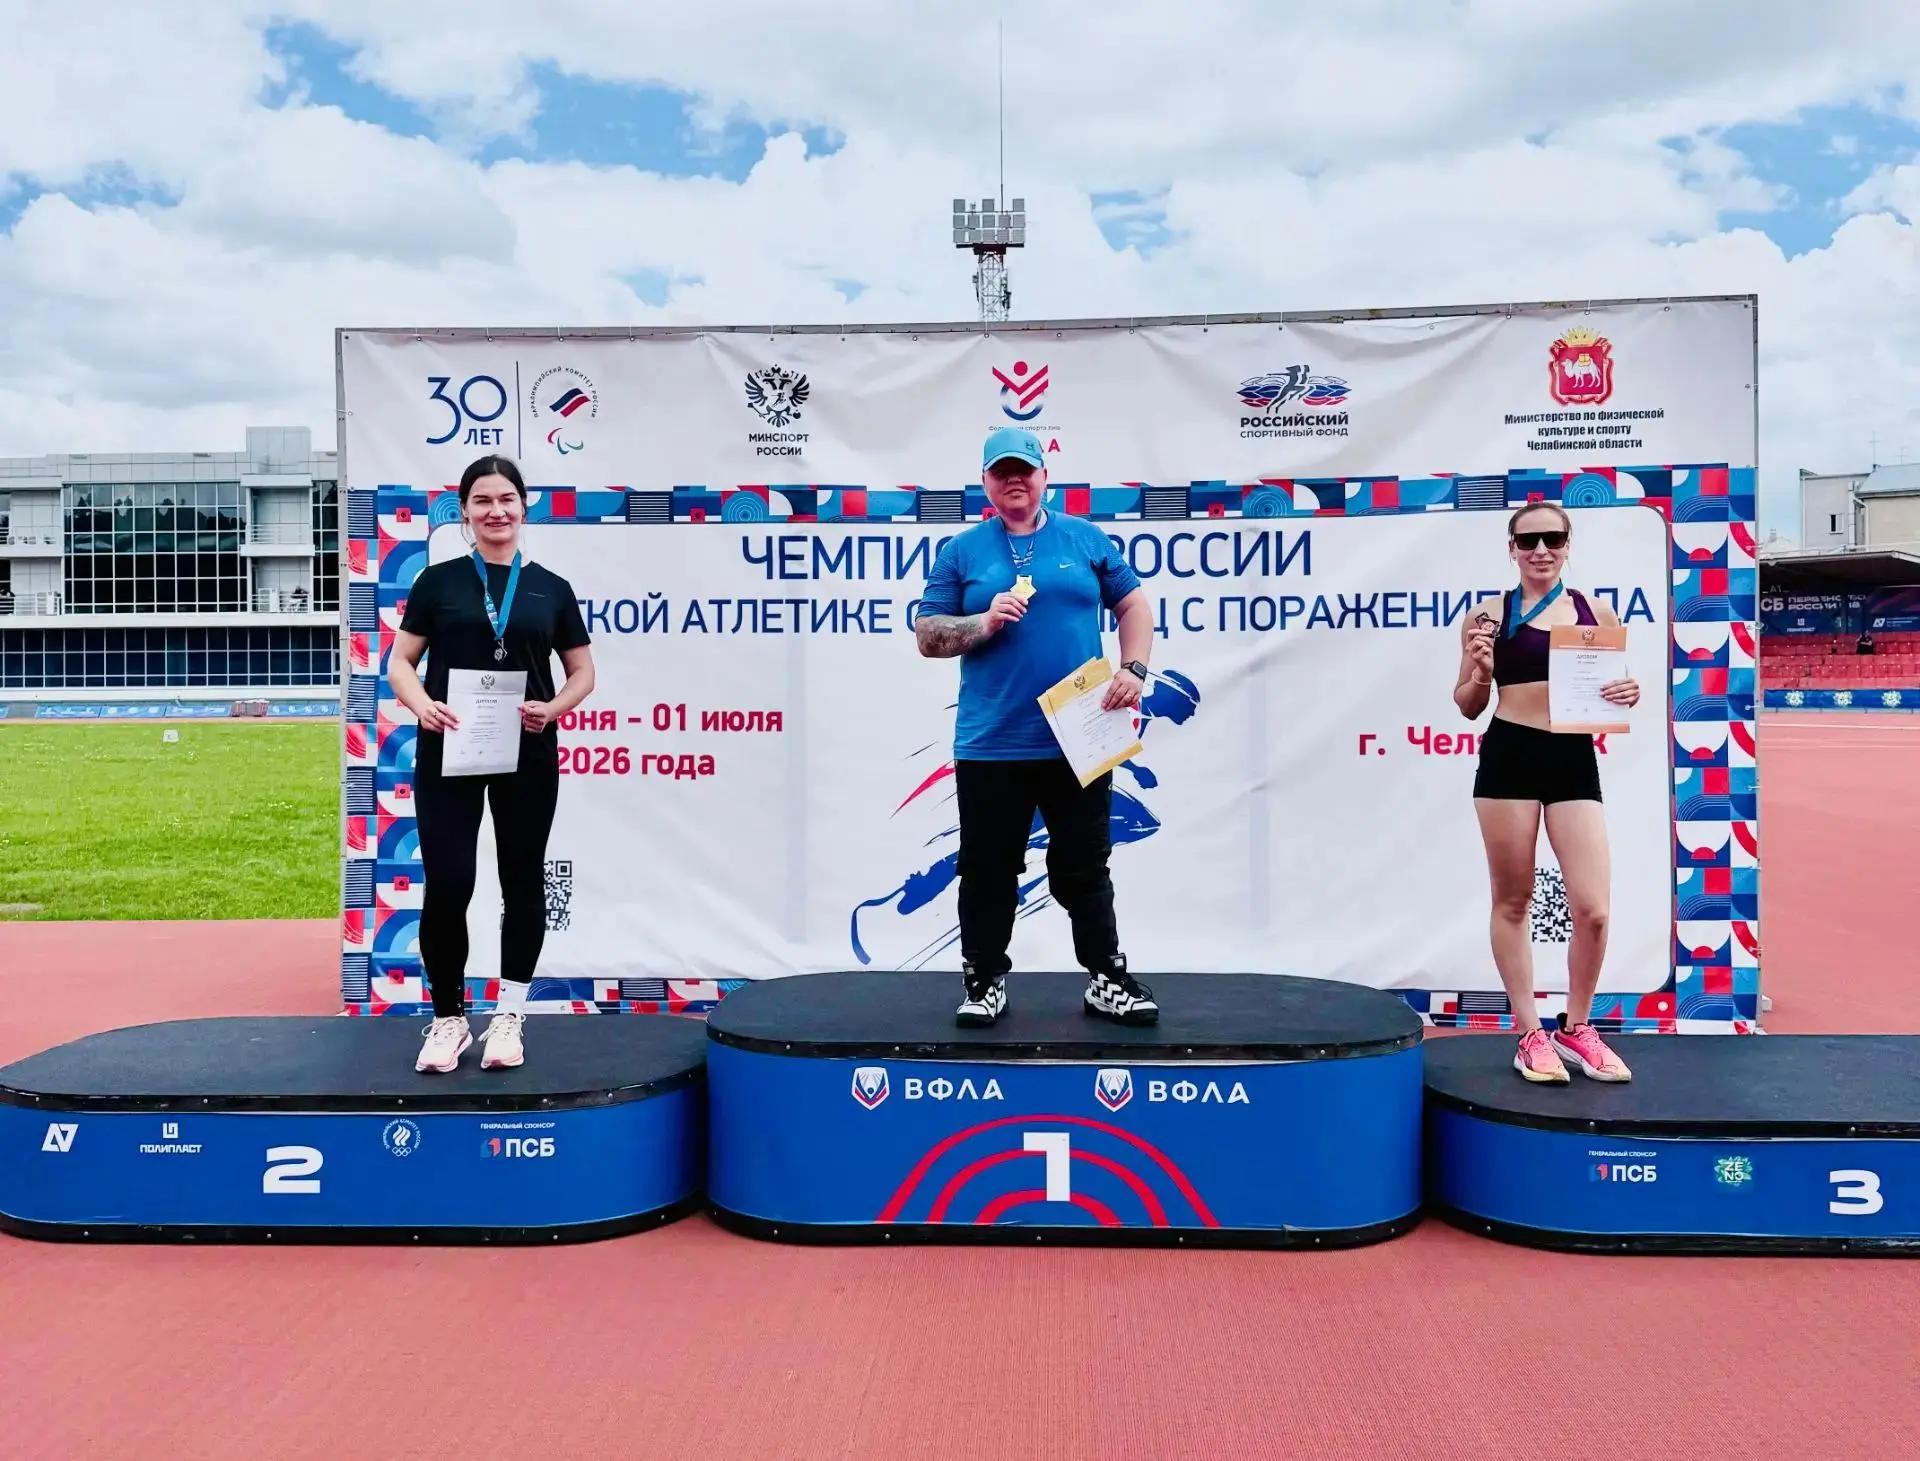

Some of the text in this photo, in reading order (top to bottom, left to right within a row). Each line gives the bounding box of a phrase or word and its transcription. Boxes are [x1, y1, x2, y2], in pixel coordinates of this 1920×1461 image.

[426, 375, 507, 444] 30
[1505, 407, 1665, 425] Министерство по физической
[1240, 411, 1349, 428] РОССИЙСКИЙ
[464, 428, 504, 445] ЛЕТ
[748, 433, 809, 443] МИНСПОРТ
[1240, 427, 1349, 438] СПОРТИВНЫЙ ФОНД
[1538, 424, 1631, 437] культуре и спорту
[756, 447, 802, 456] РОССИИ
[1527, 438, 1643, 451] Челябинской области
[742, 535, 954, 580] ЧЕМПИ
[1760, 597, 1785, 612] СБ
[681, 599, 893, 634] АТЛЕТИКЕ
[1182, 597, 1205, 632] С
[556, 710, 617, 731] юня
[653, 703, 687, 732] 01
[701, 711, 783, 732] июля
[1359, 734, 1386, 756] г.
[558, 747, 716, 780] 2026 года
[904, 1077, 1005, 1101] ВФЛА
[1148, 1080, 1250, 1104] ВФЛА
[480, 1121, 556, 1130] ГЕНЕРАЛЬНЫЙ СПОНСОР
[139, 1144, 202, 1154] ПОЛИПЛАСТ
[505, 1137, 556, 1158] ПСБ
[263, 1145, 324, 1194] 2
[1023, 1132, 1070, 1201] 1
[1612, 1164, 1657, 1182] ПСБ
[1828, 1169, 1884, 1215] 3
